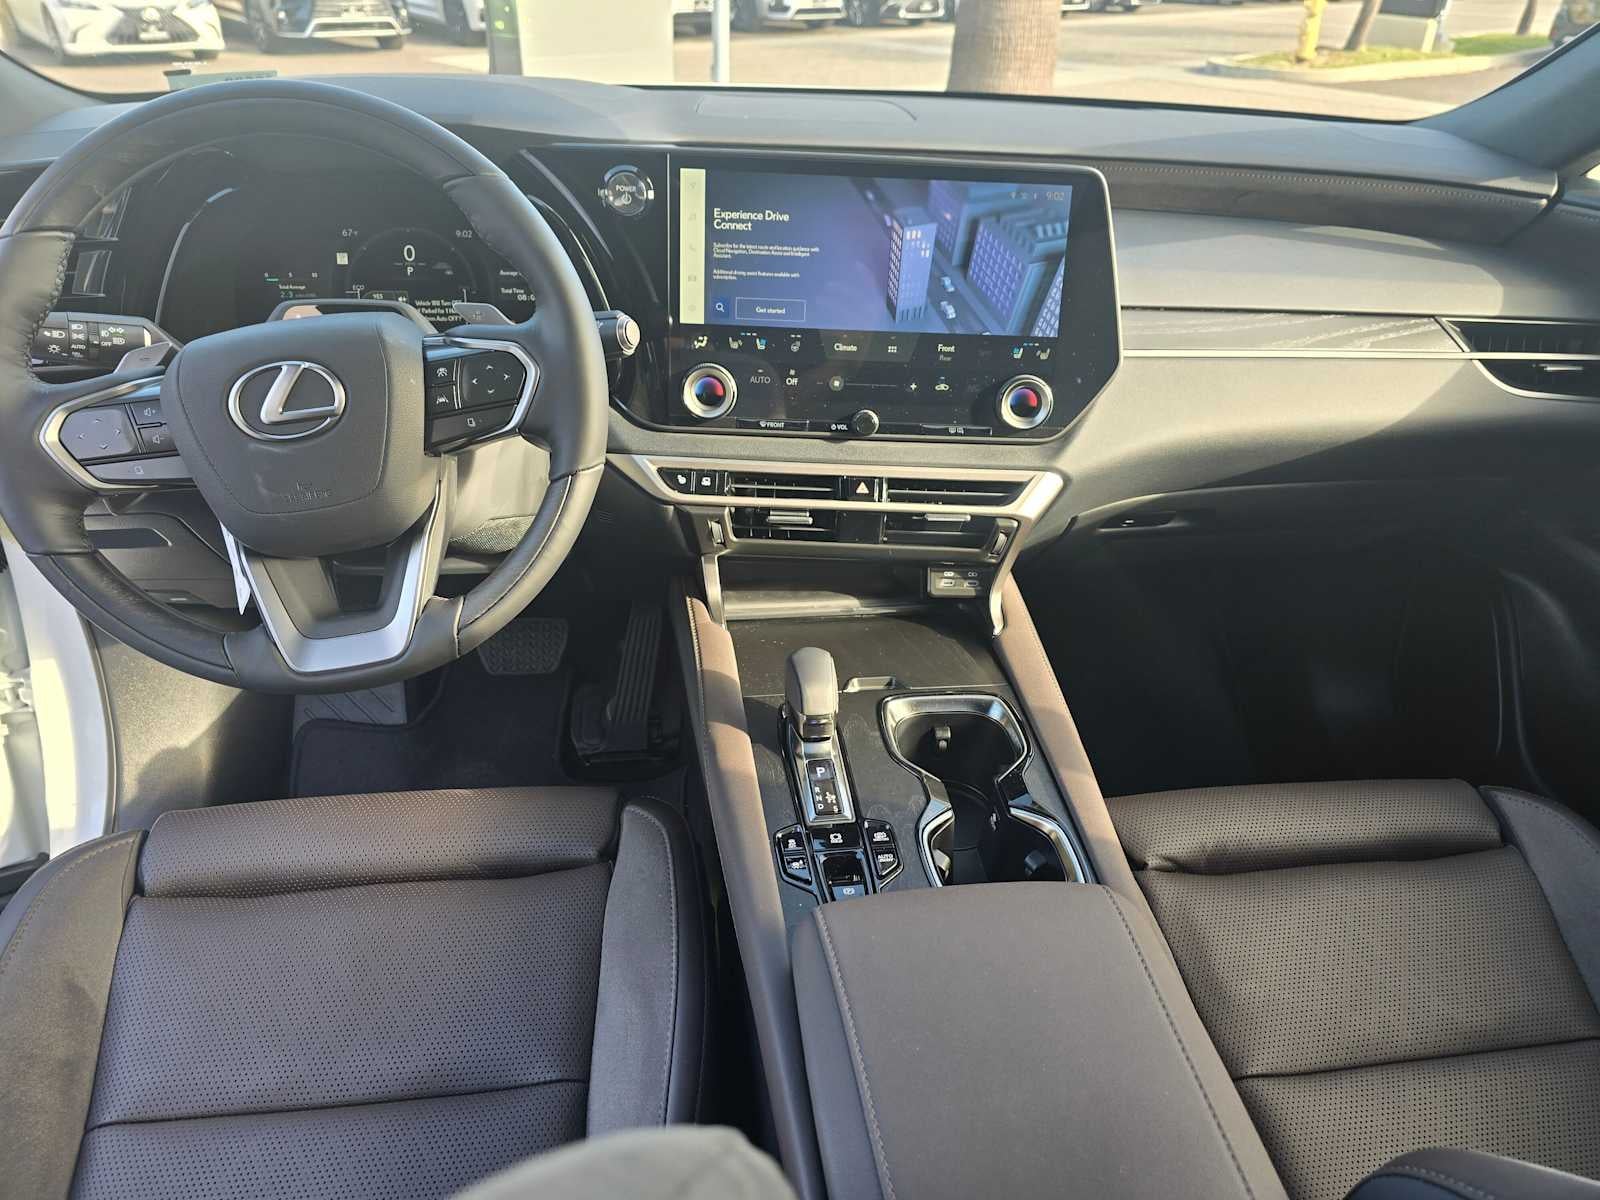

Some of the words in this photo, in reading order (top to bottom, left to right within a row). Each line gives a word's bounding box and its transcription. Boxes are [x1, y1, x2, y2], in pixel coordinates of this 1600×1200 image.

[615, 184, 637, 192] POWER
[713, 207, 764, 221] Experience
[765, 209, 790, 221] Drive
[713, 219, 752, 231] Connect
[403, 244, 416, 262] 0
[406, 266, 414, 276] P
[834, 342, 858, 352] Climate
[938, 344, 956, 352] Front
[750, 375, 770, 384] AUTO
[786, 378, 798, 386] Off
[816, 766, 826, 778] P
